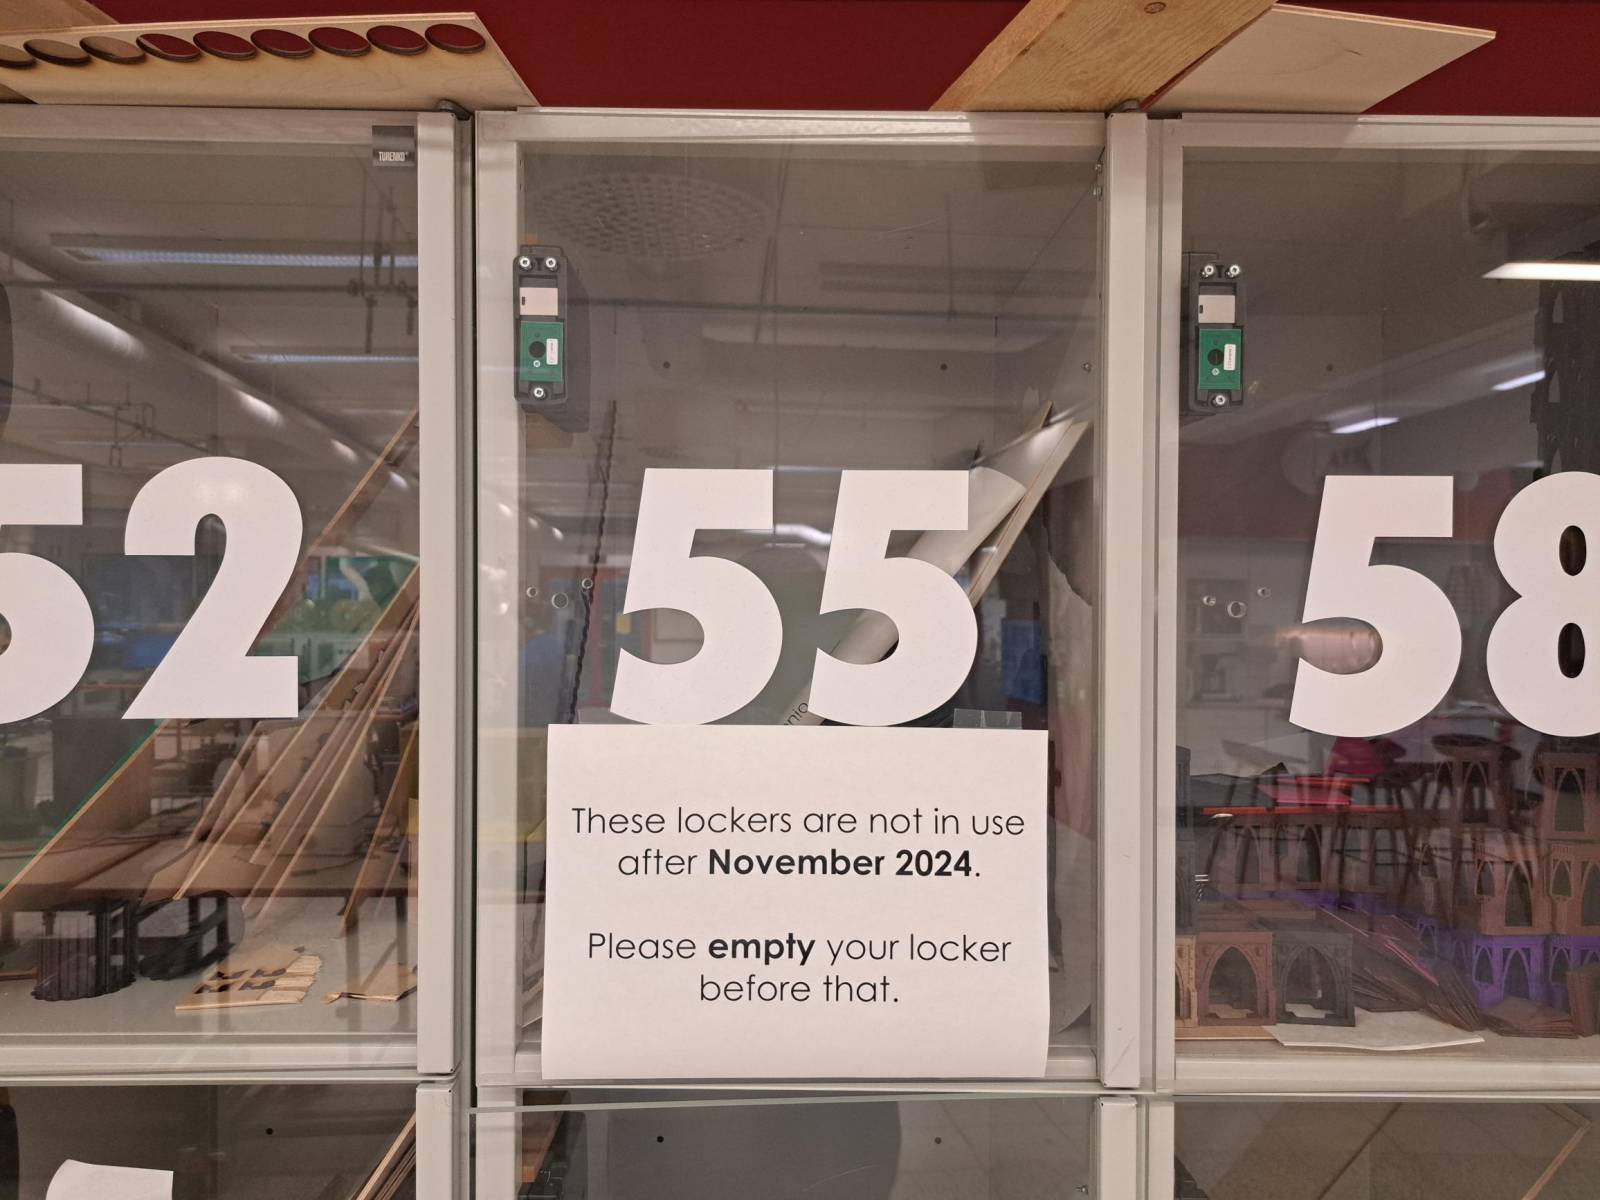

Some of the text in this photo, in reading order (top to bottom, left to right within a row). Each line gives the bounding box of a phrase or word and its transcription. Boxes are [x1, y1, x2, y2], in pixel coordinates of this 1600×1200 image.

[610, 468, 978, 727] 55
[1290, 472, 1600, 737] 58
[572, 807, 1025, 836] These lockers are not in use
[619, 848, 980, 878] after November 2024.
[589, 932, 1012, 967] Please empty your locker
[701, 974, 899, 1003] before that.
